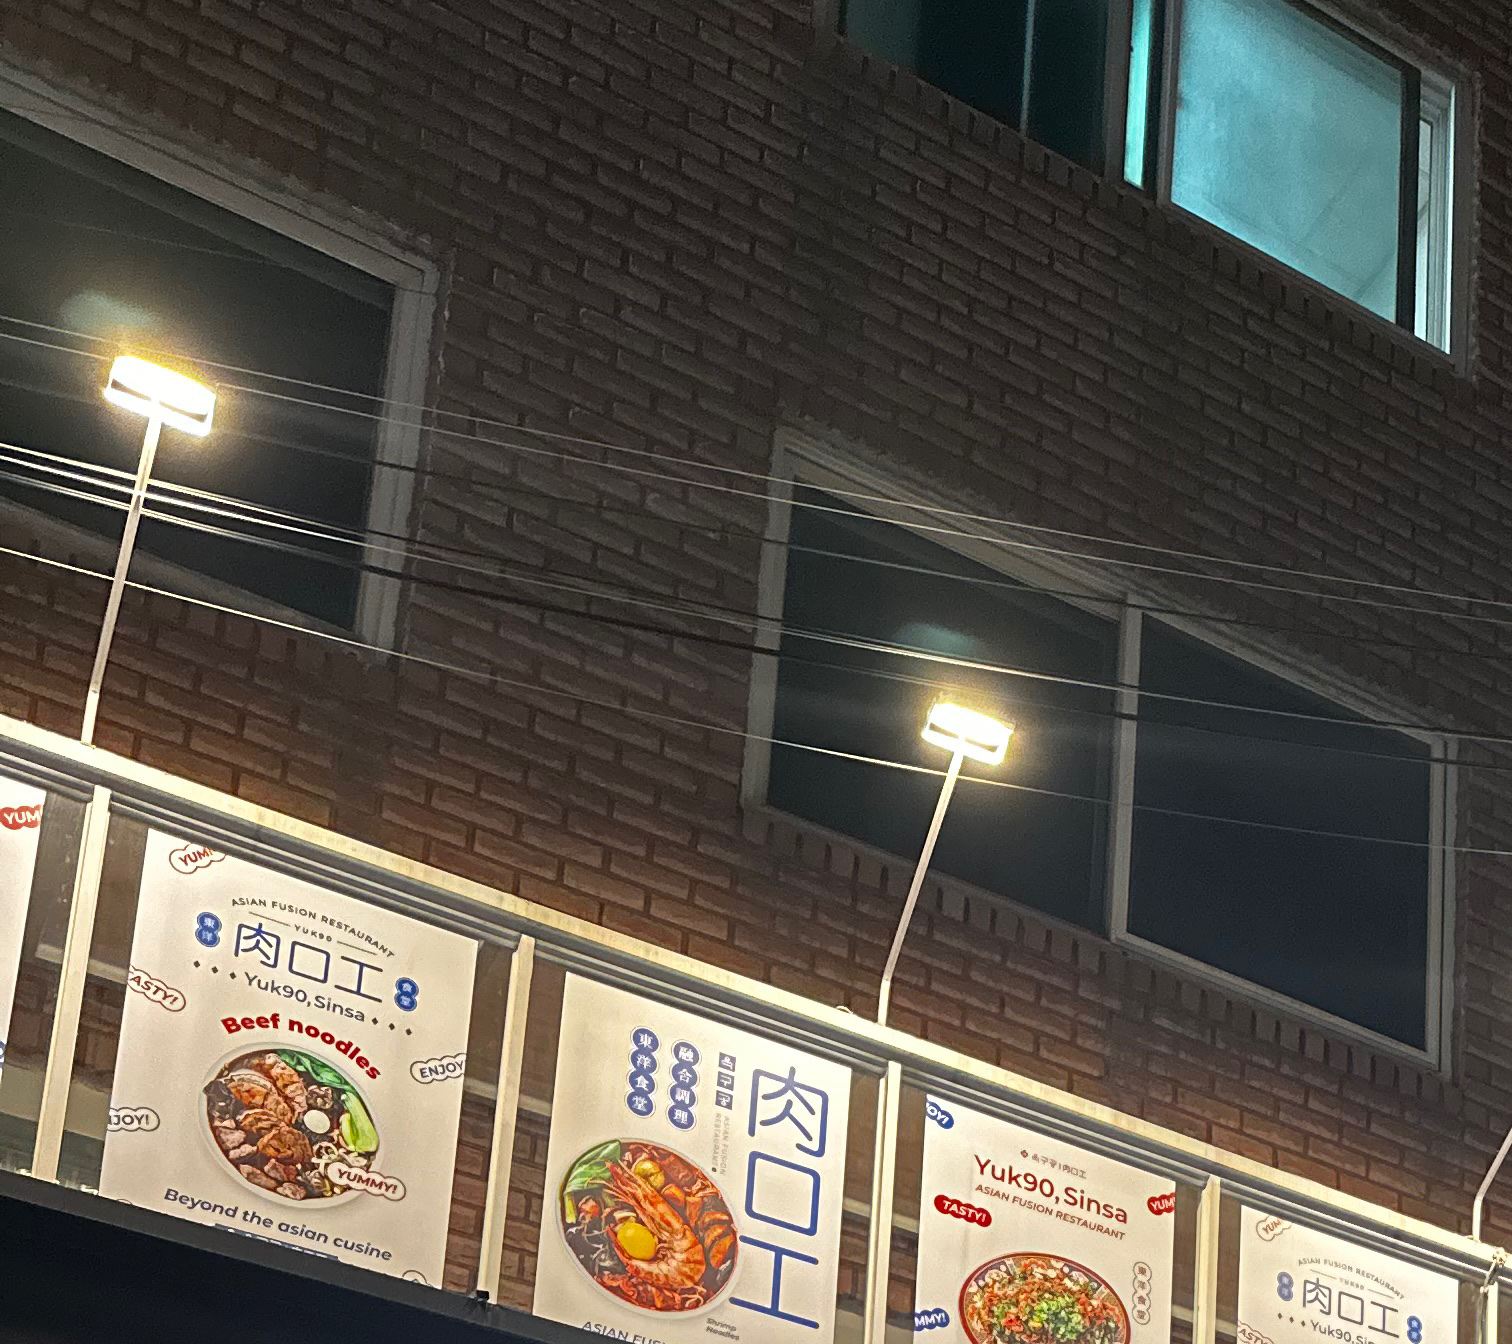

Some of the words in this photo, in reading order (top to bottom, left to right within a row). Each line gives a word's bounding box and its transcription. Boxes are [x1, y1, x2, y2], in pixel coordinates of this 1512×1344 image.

[232, 897, 267, 908] ASIAN
[271, 900, 318, 921] FUSION
[321, 914, 395, 959] RESTAURANT
[293, 923, 333, 943] YUK90
[244, 971, 365, 1022] Yuk90,Sinsa
[221, 1013, 281, 1035] Beef
[288, 1017, 382, 1080] noodles
[336, 1167, 399, 1195] YUMMY!
[973, 1154, 1128, 1225] Yuk90,Sinsa
[162, 1187, 238, 1220] Beyond
[242, 1209, 275, 1229] the
[277, 1222, 329, 1245] asian
[333, 1236, 394, 1262] cusine
[942, 1199, 987, 1224] TASTY!
[975, 1184, 1009, 1202] ASIAN
[1011, 1195, 1053, 1217] FUSION
[1055, 1210, 1126, 1241] RESTAURANT
[1355, 1265, 1405, 1300] RESTAURANT
[582, 1321, 629, 1341] ASIAN
